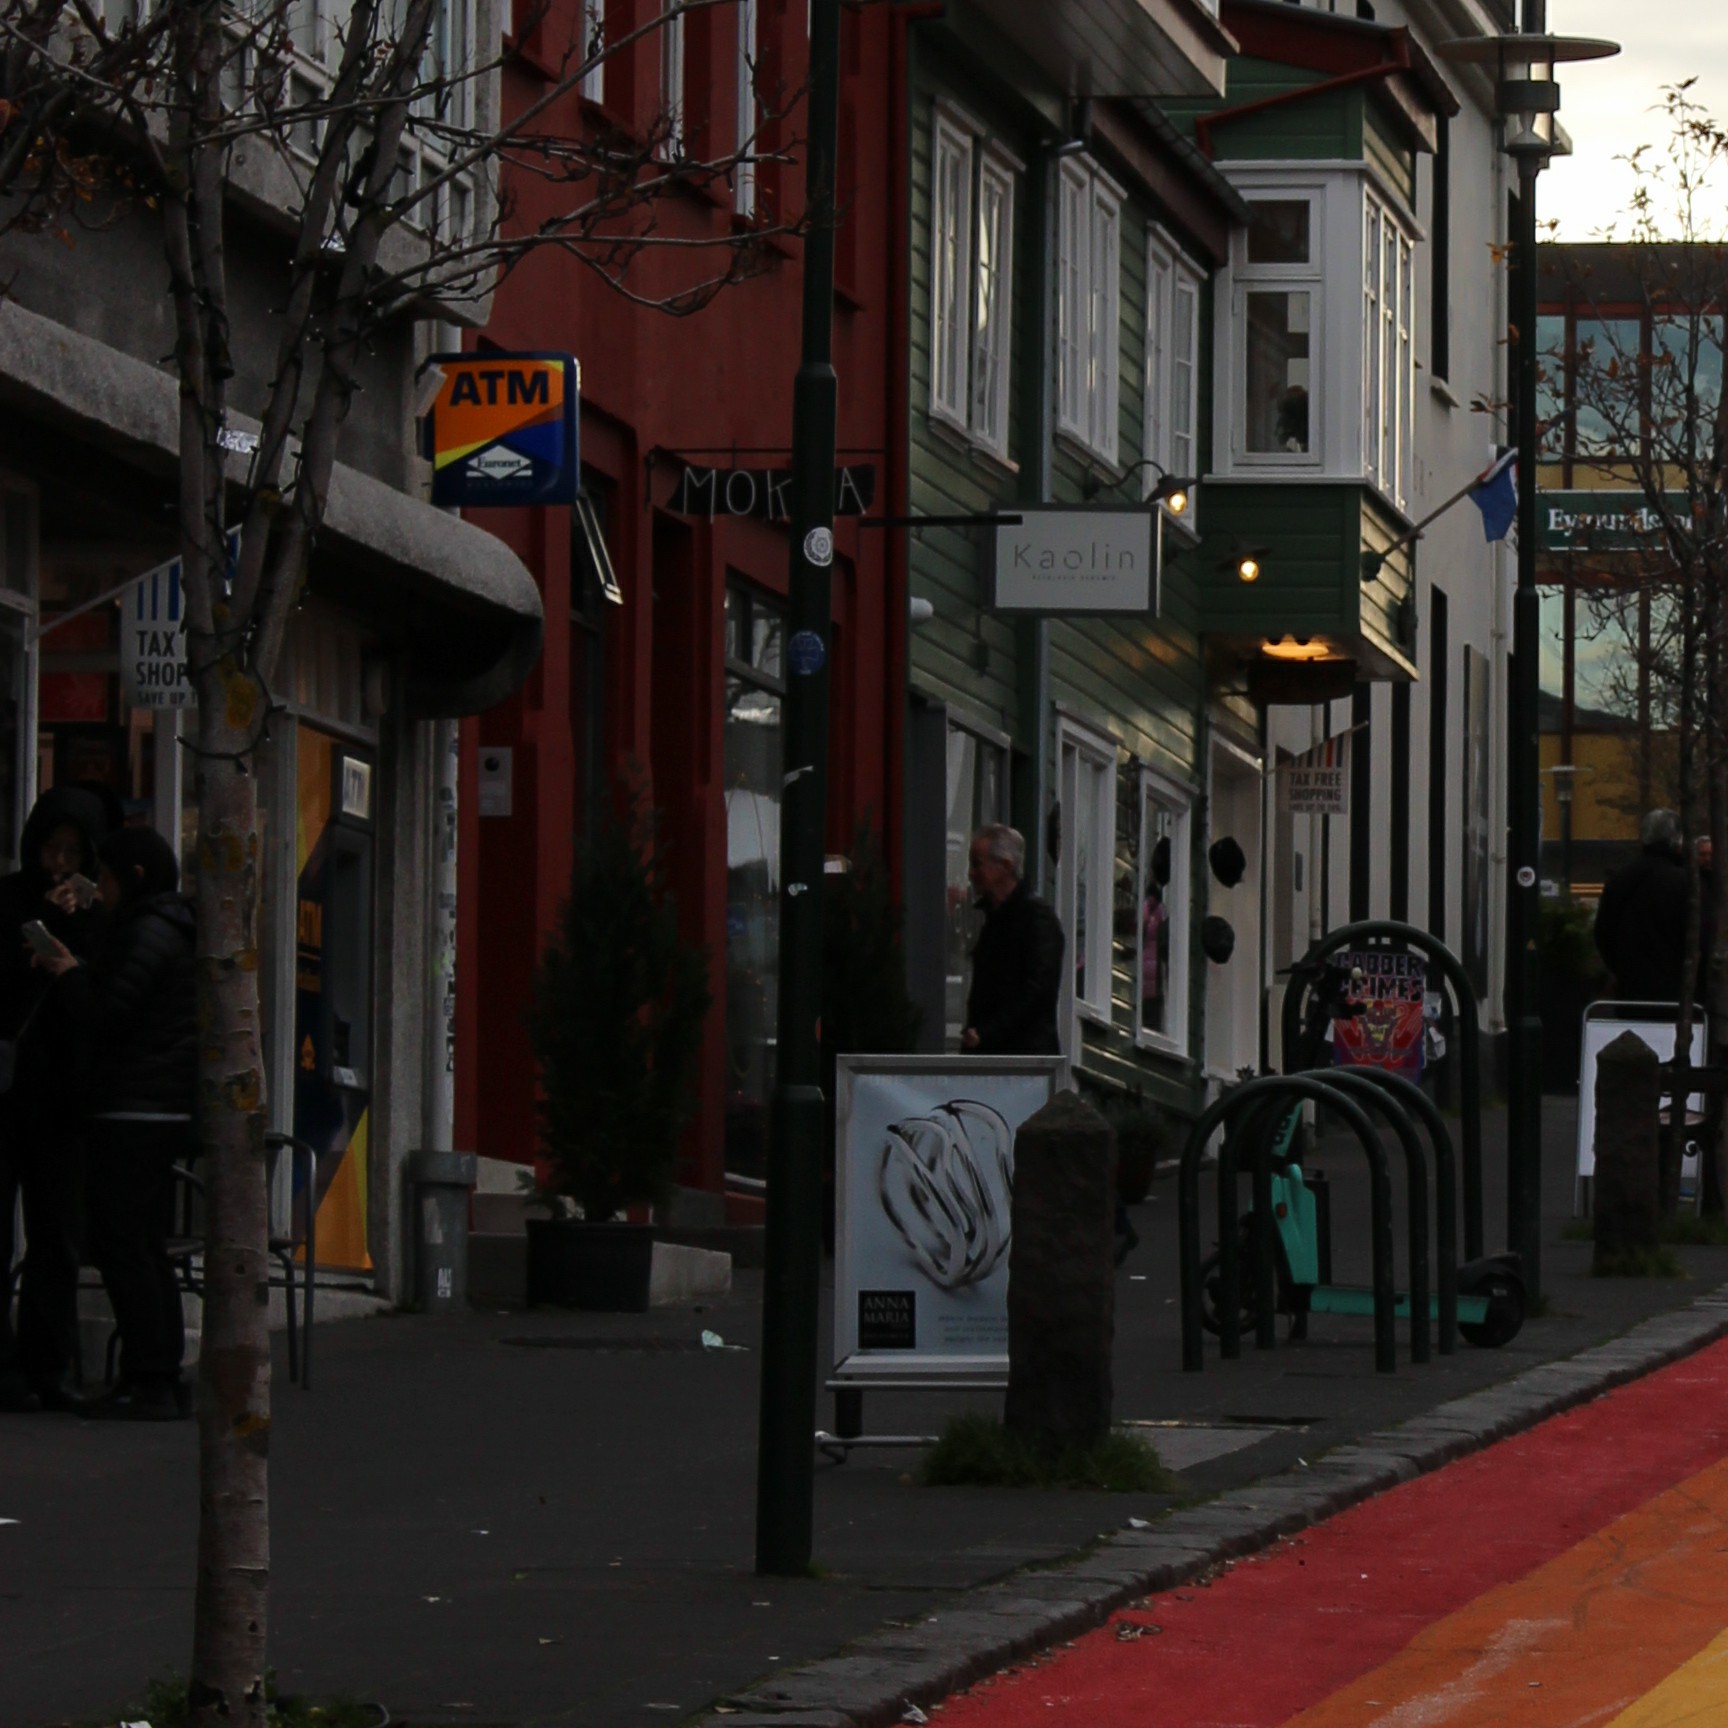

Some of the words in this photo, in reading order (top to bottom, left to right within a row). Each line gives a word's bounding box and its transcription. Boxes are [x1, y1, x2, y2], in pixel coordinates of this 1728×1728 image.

[451, 371, 549, 405] ATM
[477, 457, 522, 470] Euronet
[683, 466, 867, 524] MOKA
[1013, 542, 1135, 570] Kaolin
[136, 630, 176, 657] TAX
[1290, 773, 1310, 786] TAX
[1314, 773, 1342, 786] FREE
[864, 1297, 910, 1310] ANNA
[864, 1311, 910, 1325] MARIA
